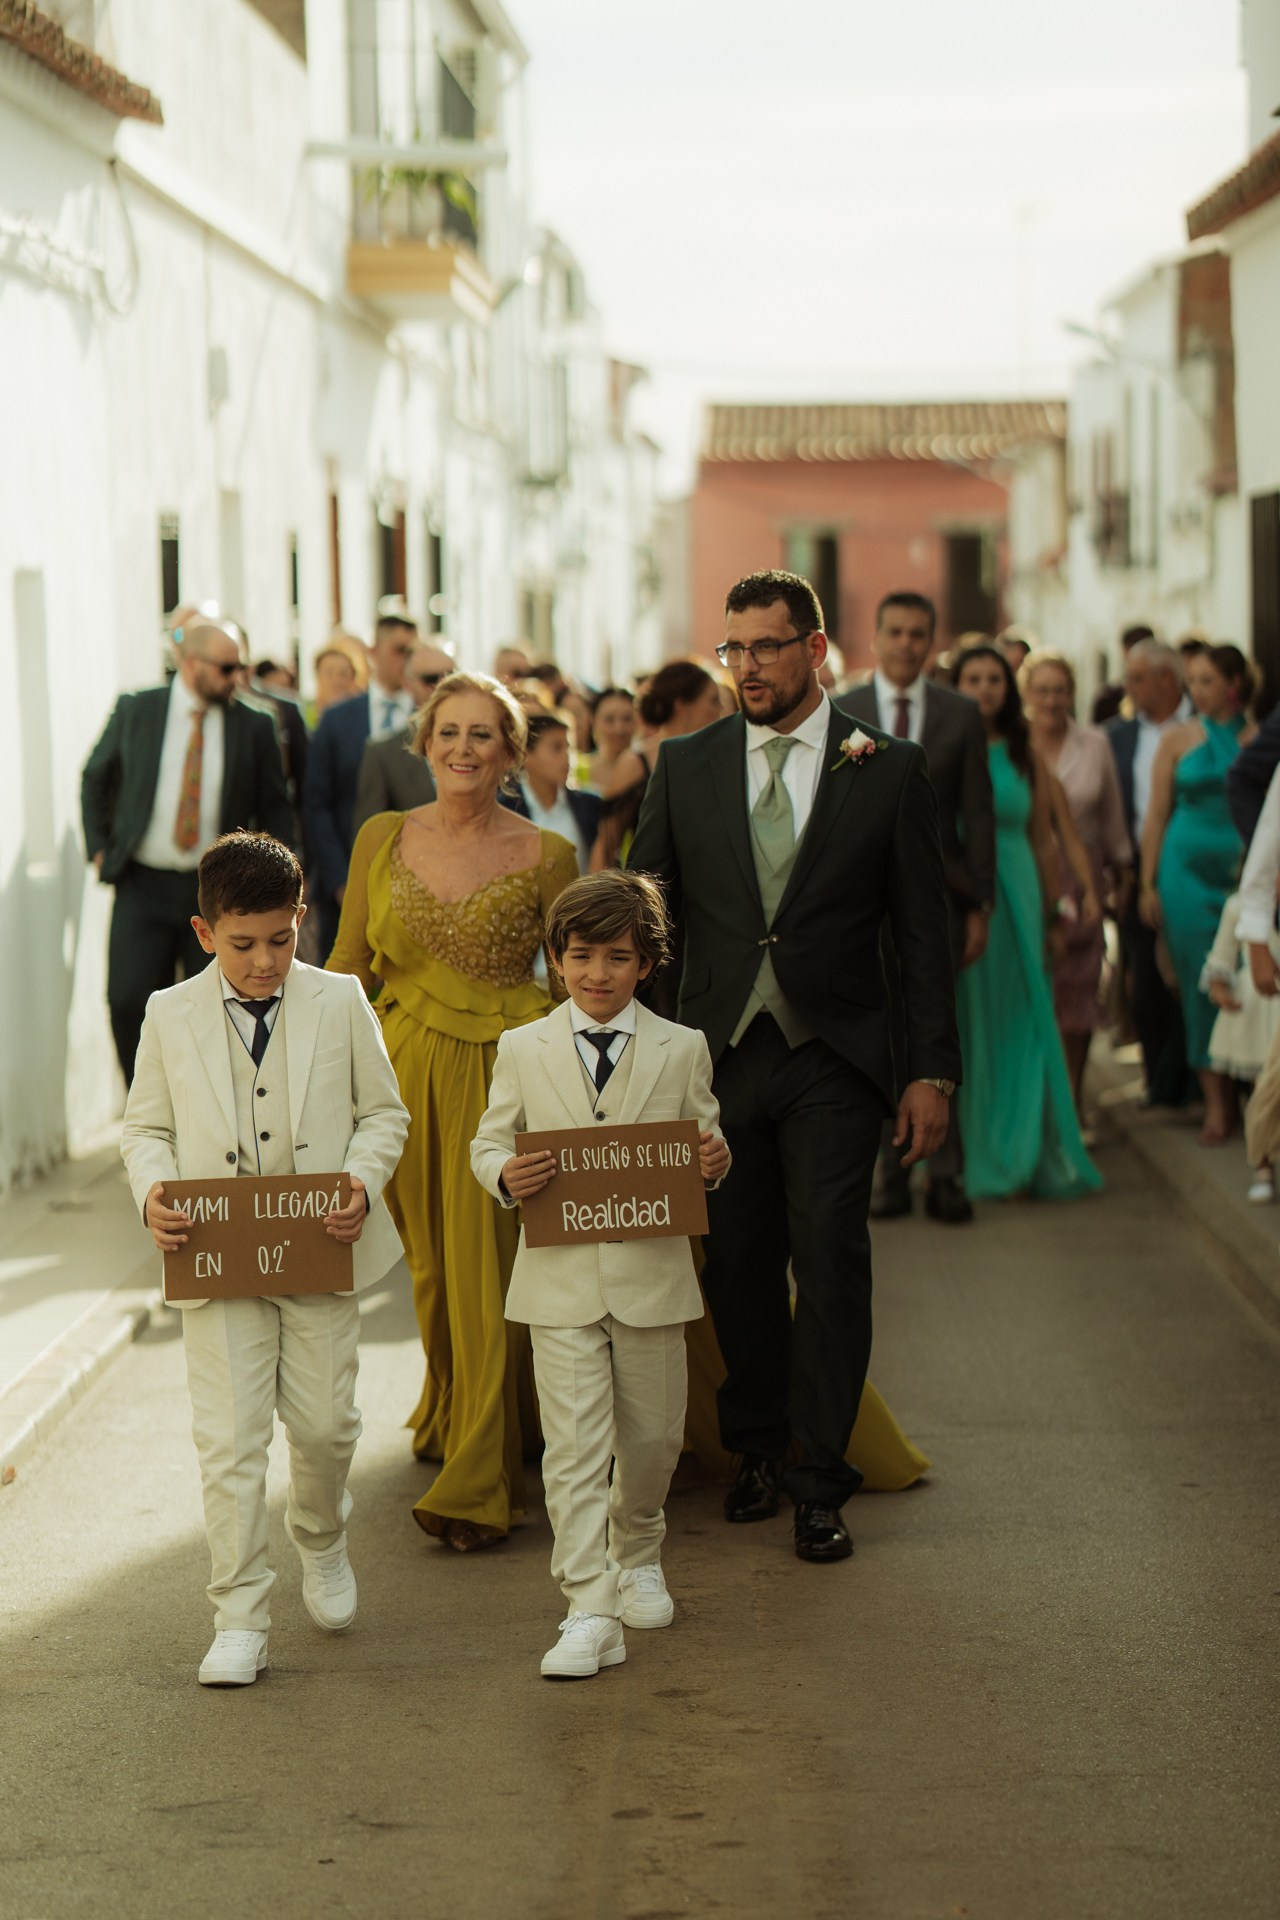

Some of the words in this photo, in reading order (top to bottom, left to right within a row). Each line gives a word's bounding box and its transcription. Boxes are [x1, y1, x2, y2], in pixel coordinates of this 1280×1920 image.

[560, 1148, 578, 1172] EL
[582, 1141, 631, 1170] SUEÑO
[636, 1144, 654, 1168] SE
[658, 1142, 692, 1168] HIZO
[173, 1196, 229, 1223] MAMI
[254, 1181, 341, 1219] LLEGARÁ
[561, 1193, 671, 1231] Realidad
[195, 1252, 222, 1278] EN
